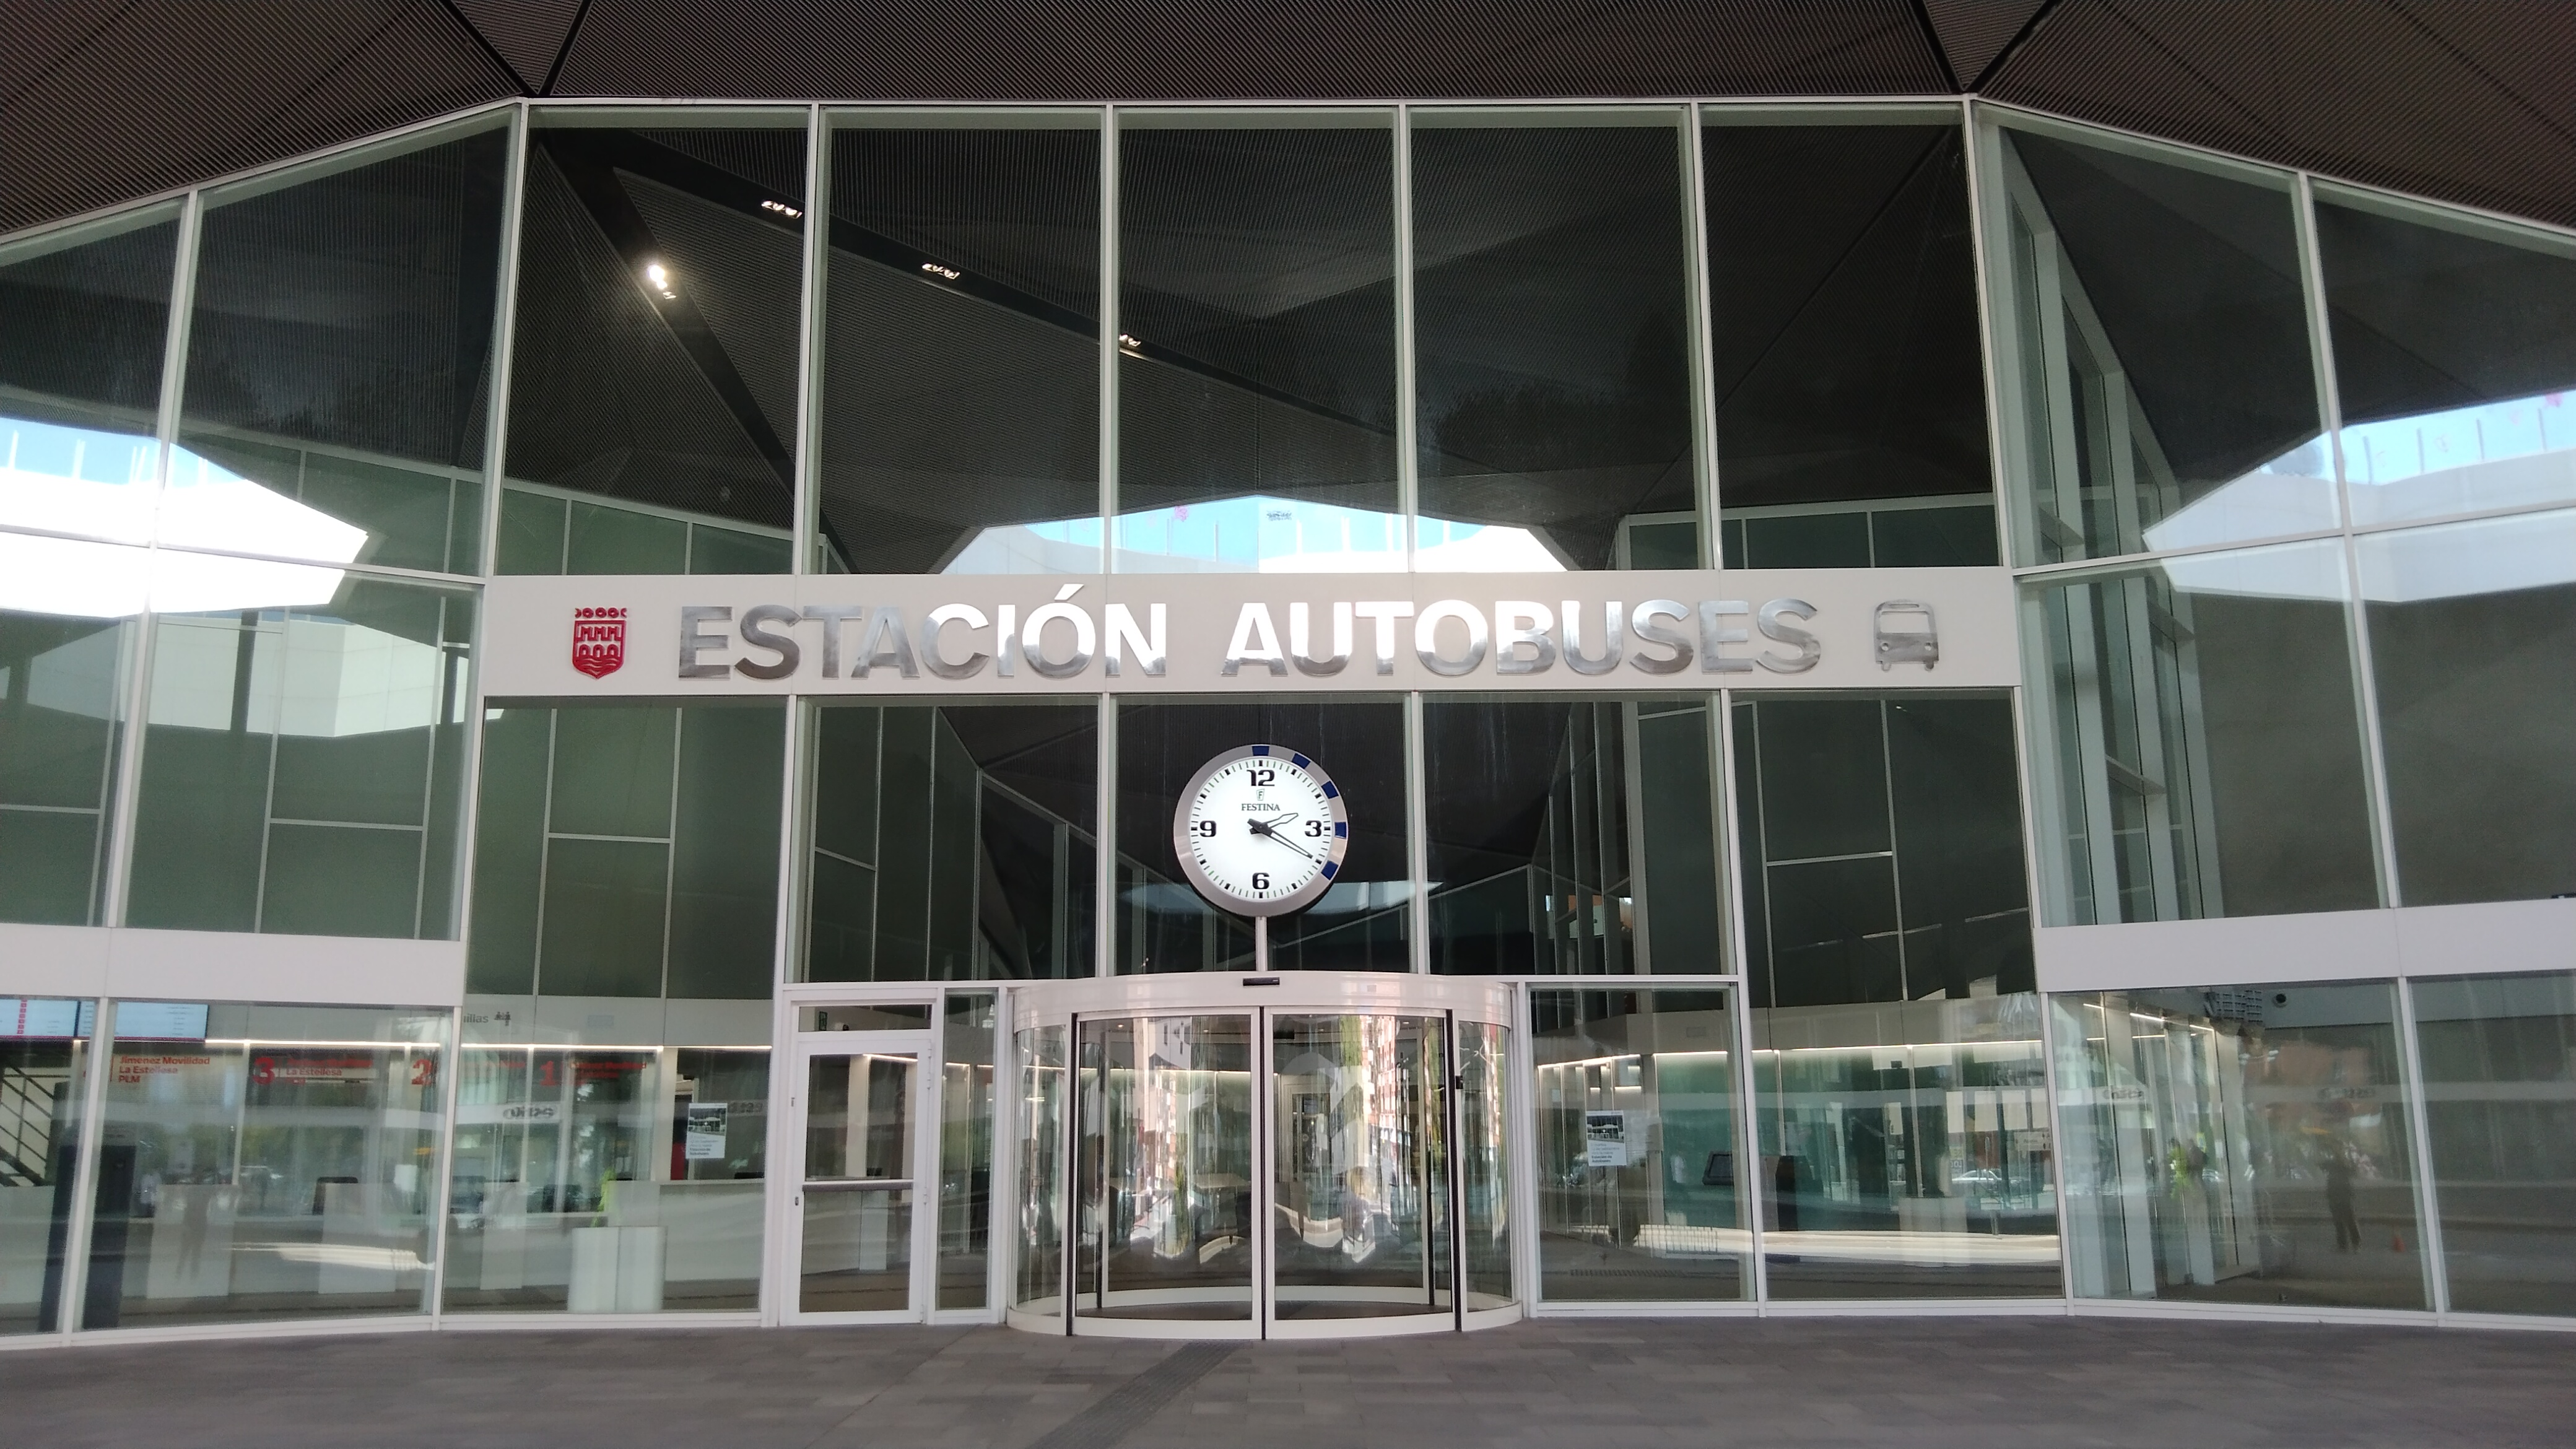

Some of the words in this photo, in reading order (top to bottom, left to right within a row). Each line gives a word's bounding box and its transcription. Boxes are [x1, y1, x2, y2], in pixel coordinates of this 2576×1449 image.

[679, 583, 1167, 680] ESTACIÓN
[1221, 598, 1821, 677] AUTOBUSES
[1247, 769, 1275, 786] 12
[1241, 803, 1281, 811] FESTINA
[1199, 820, 1217, 837] 9
[1305, 820, 1322, 837] 3
[1252, 872, 1270, 890] 6
[162, 1056, 210, 1064] Movilidad
[119, 1066, 131, 1074] La
[253, 1056, 275, 1085] 3
[411, 1058, 433, 1086] 2
[539, 1060, 556, 1086] 1
